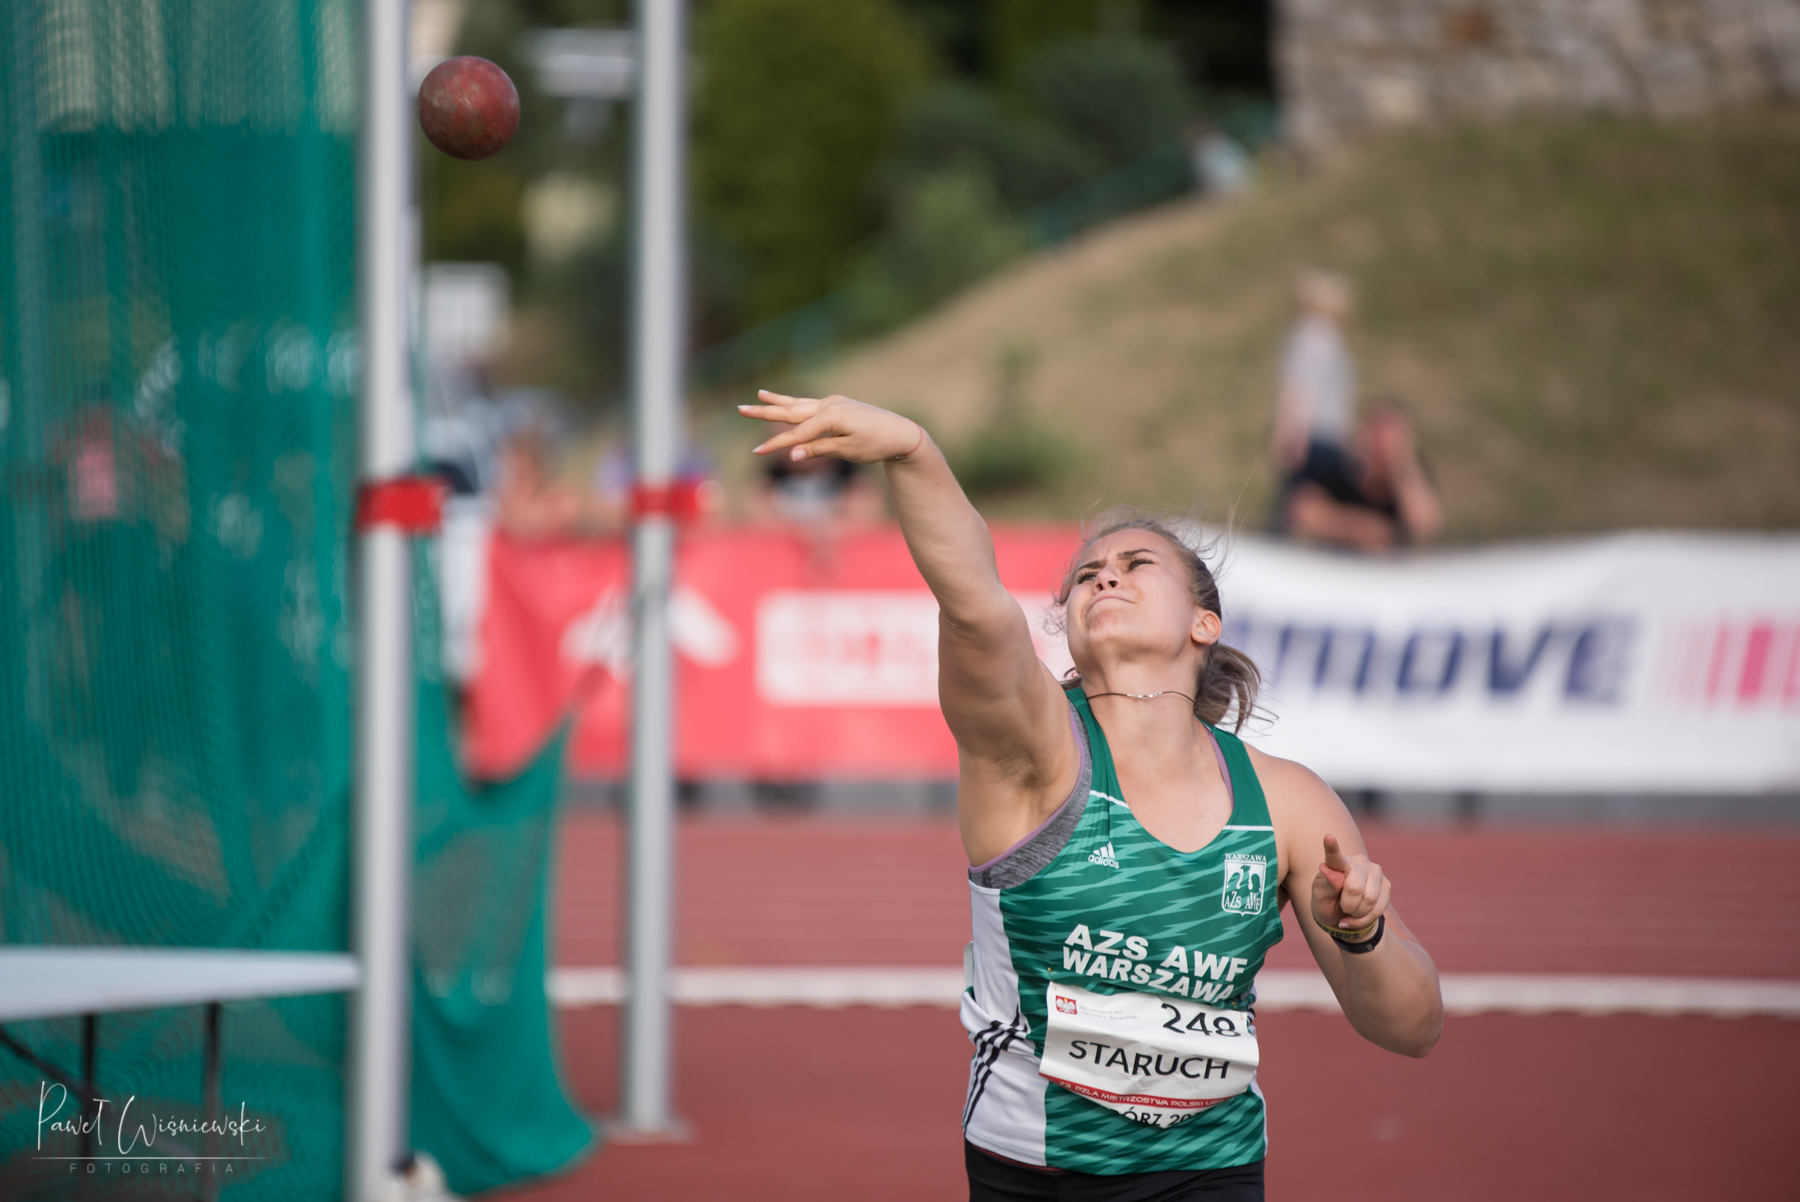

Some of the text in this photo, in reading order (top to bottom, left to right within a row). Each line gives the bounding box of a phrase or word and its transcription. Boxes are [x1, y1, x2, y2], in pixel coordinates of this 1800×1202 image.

[1088, 854, 1119, 869] adidas
[1225, 853, 1267, 862] WARSZAWA
[1225, 891, 1261, 910] AZS AWF
[1064, 924, 1248, 982] AZS AWF
[1063, 946, 1234, 1003] WARSZAWA
[1160, 1003, 1241, 1037] 248
[1068, 1040, 1231, 1079] STARUCH
[1074, 1086, 1099, 1097] PZLA
[1100, 1093, 1169, 1106] MISTRZOSTWA
[1122, 1106, 1192, 1127] ÓRZ 20
